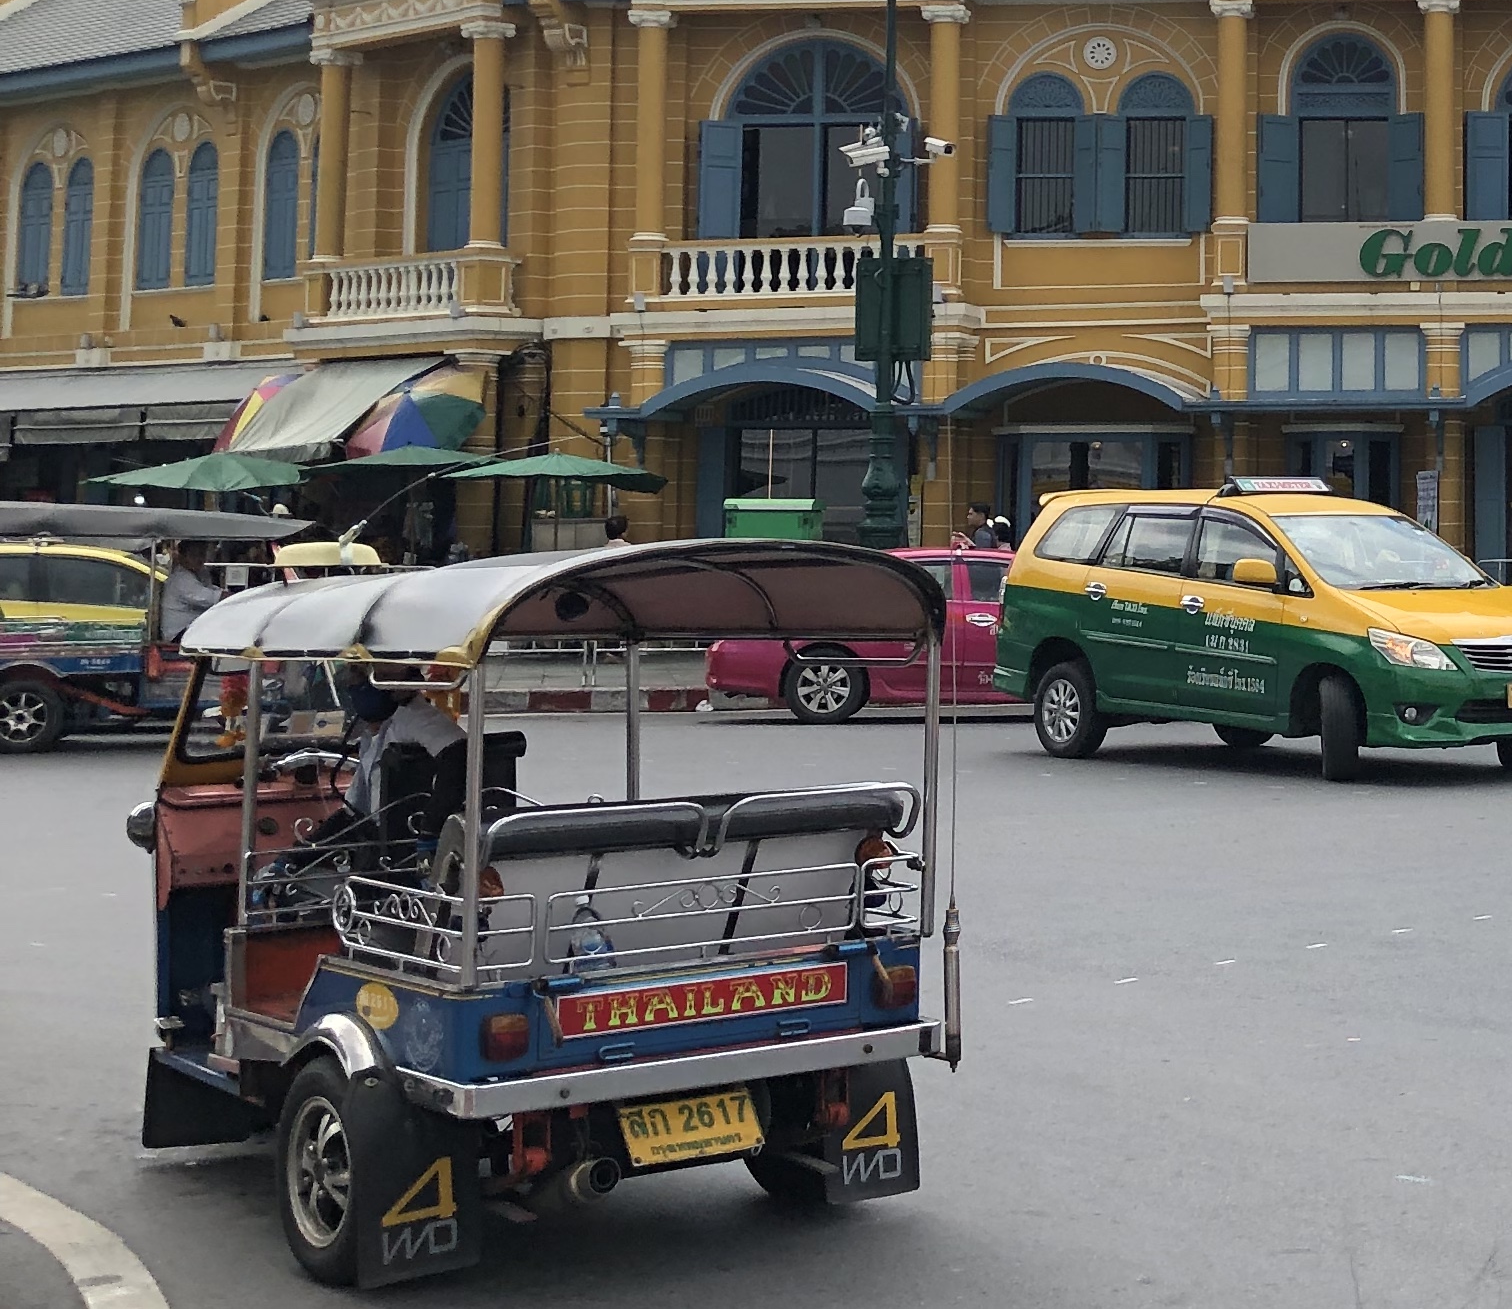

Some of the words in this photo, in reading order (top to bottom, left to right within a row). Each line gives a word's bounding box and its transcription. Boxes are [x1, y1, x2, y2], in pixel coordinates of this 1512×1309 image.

[577, 971, 832, 1031] THAILAND
[678, 1094, 747, 1132] 2617
[842, 1091, 900, 1150] 4
[382, 1156, 457, 1227] 4
[842, 1148, 901, 1185] WD
[382, 1218, 457, 1265] WD
